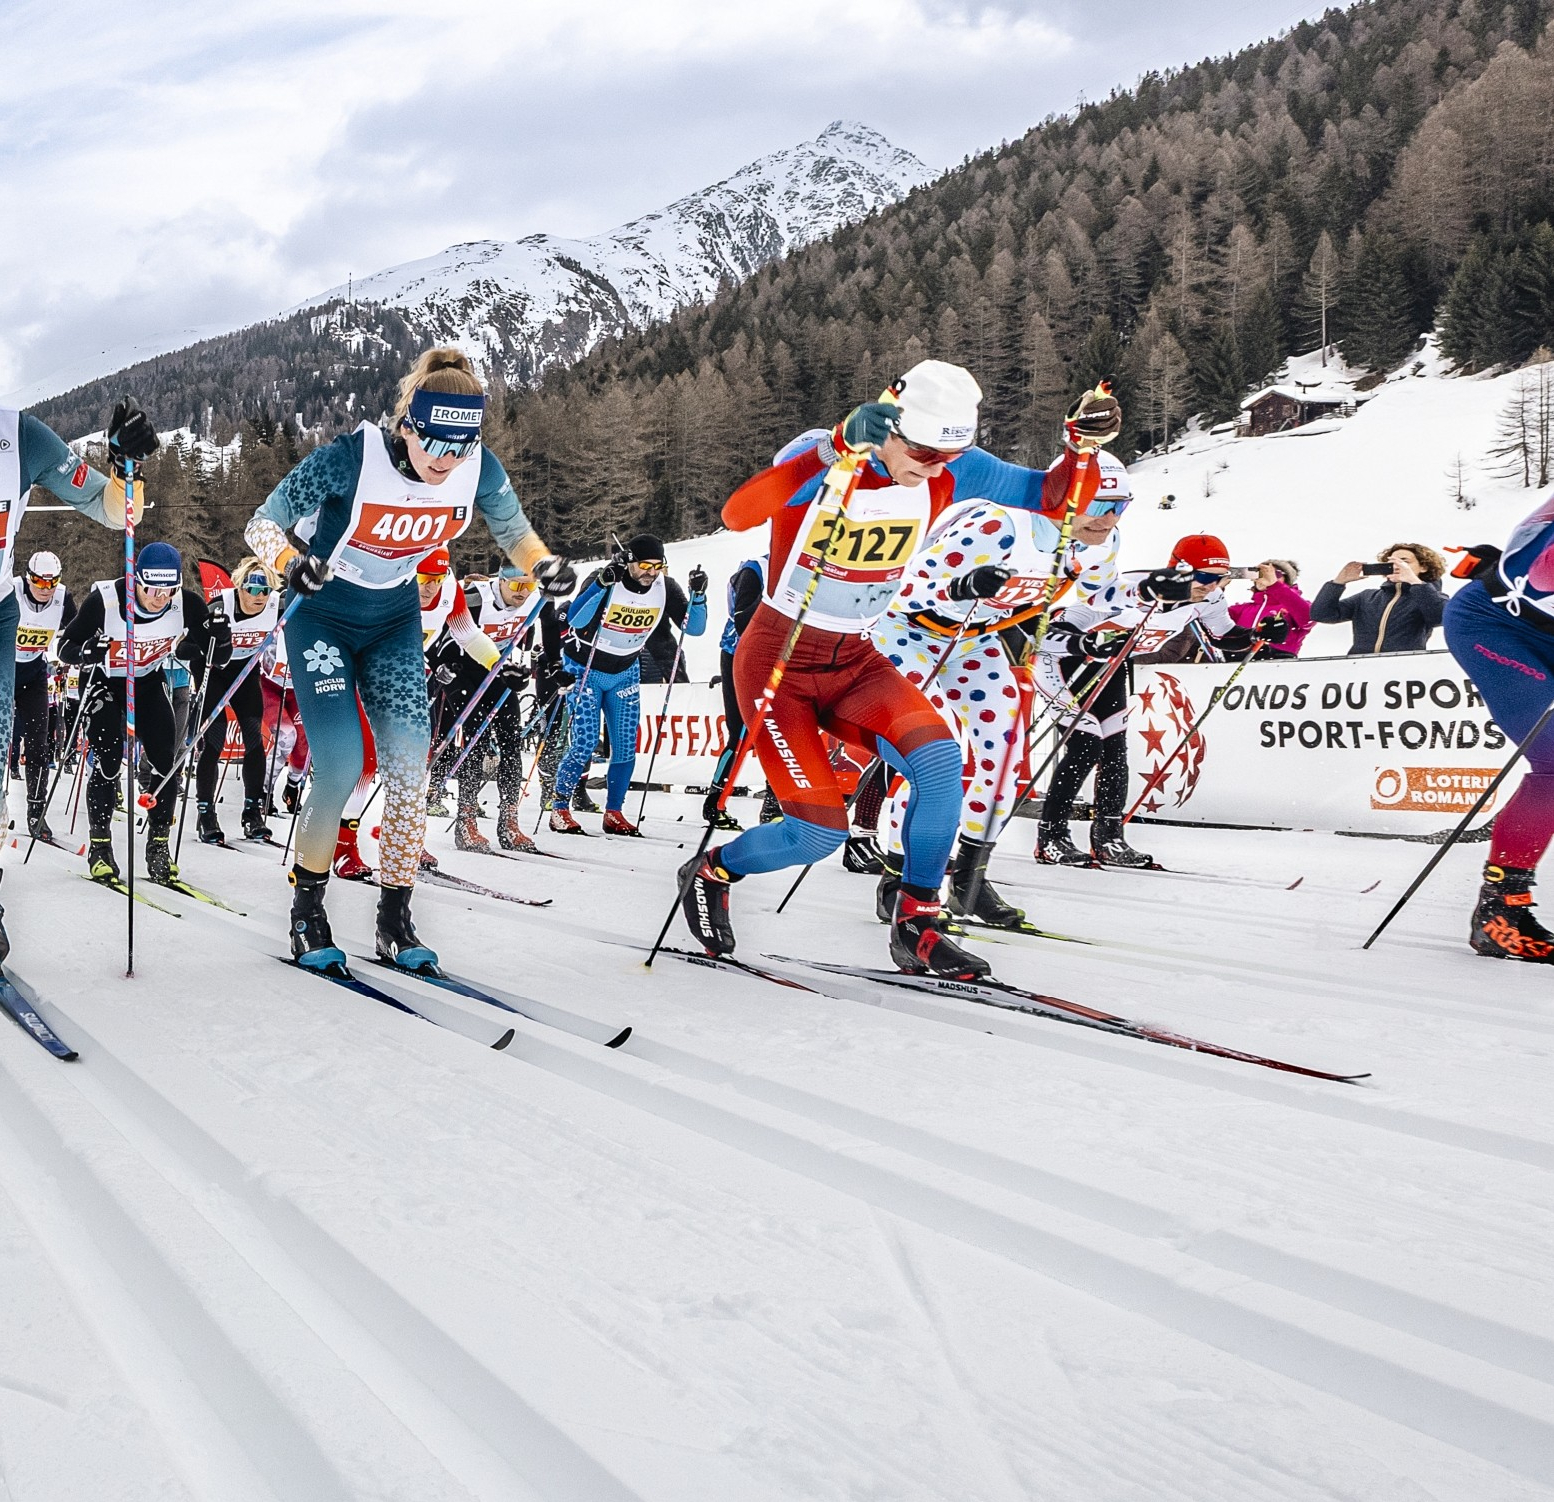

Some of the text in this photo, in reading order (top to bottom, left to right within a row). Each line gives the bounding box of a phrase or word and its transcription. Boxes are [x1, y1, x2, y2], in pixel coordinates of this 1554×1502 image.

[0, 502, 7, 512] E
[456, 508, 464, 519] E
[371, 513, 448, 542] 4001
[811, 519, 914, 562] 2127
[150, 570, 177, 579] swisscom
[1017, 579, 1046, 587] YVES
[620, 606, 650, 615] GIULIANO
[608, 612, 655, 627] 2080
[115, 644, 166, 661] 4127
[315, 677, 346, 687] SKICLUB
[315, 684, 346, 694] HORW
[1210, 679, 1486, 711] FONDS DU SPOR
[635, 714, 758, 757] IFFEIS
[1259, 719, 1507, 750] SPORT-FONDS
[763, 718, 813, 790] MADSHUS
[1426, 774, 1495, 789] LOTERI
[693, 877, 715, 939] MADSHUS
[916, 905, 942, 913] MADS
[937, 980, 979, 995] MADSHUS
